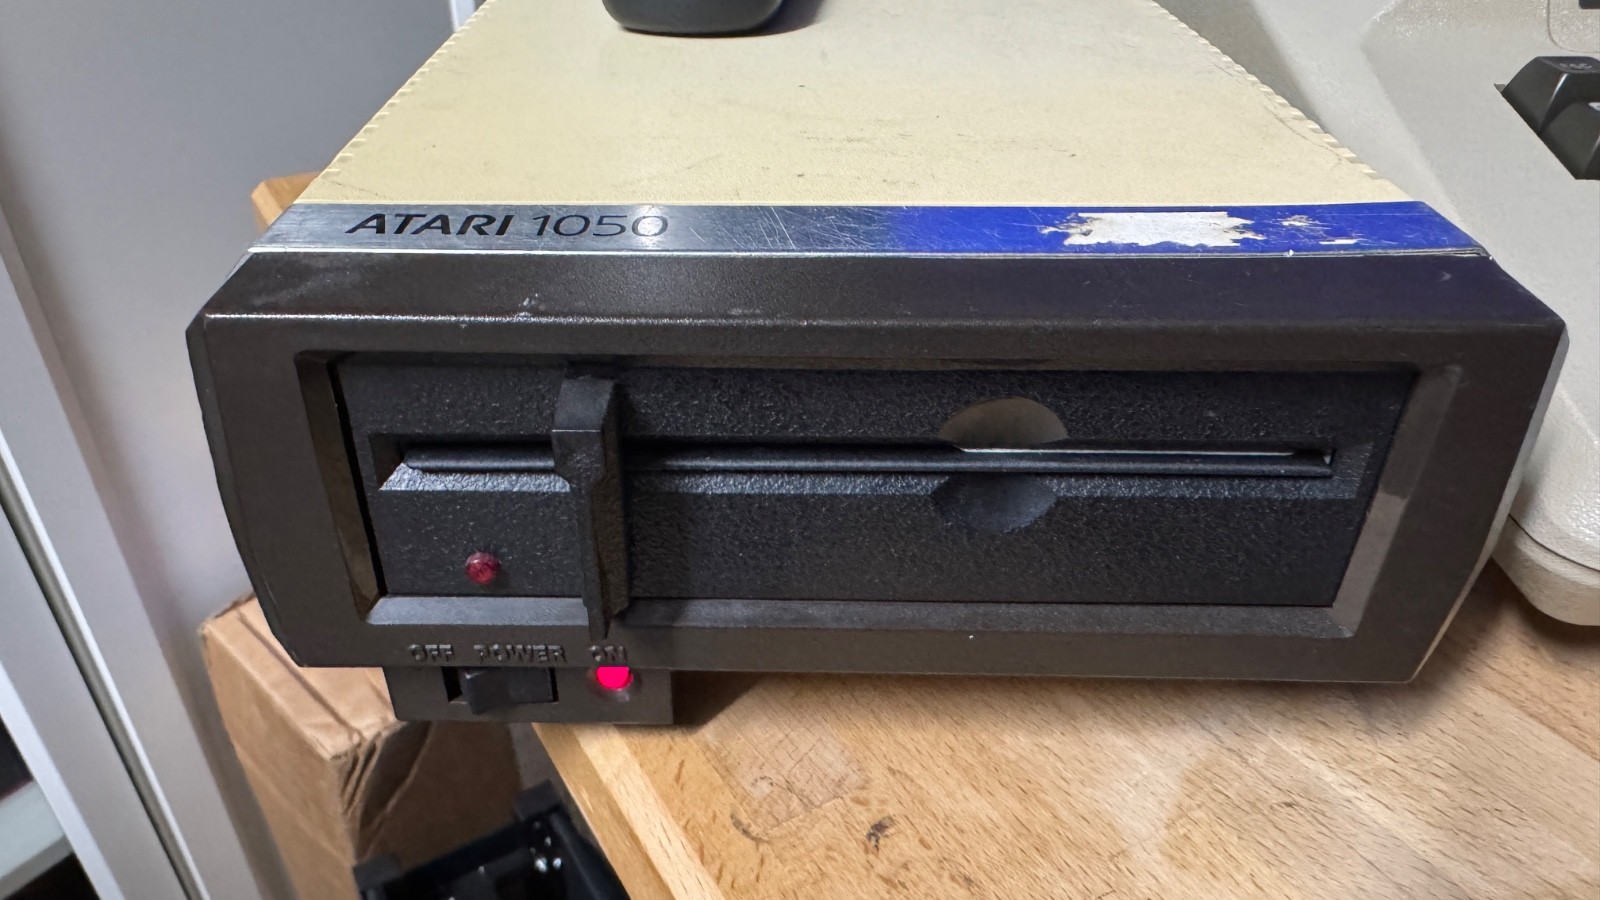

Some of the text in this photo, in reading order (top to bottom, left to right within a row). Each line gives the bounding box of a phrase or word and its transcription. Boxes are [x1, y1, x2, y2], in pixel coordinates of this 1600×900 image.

[344, 213, 669, 237] ATARI 1050
[408, 643, 628, 663] OFF POWER ON
